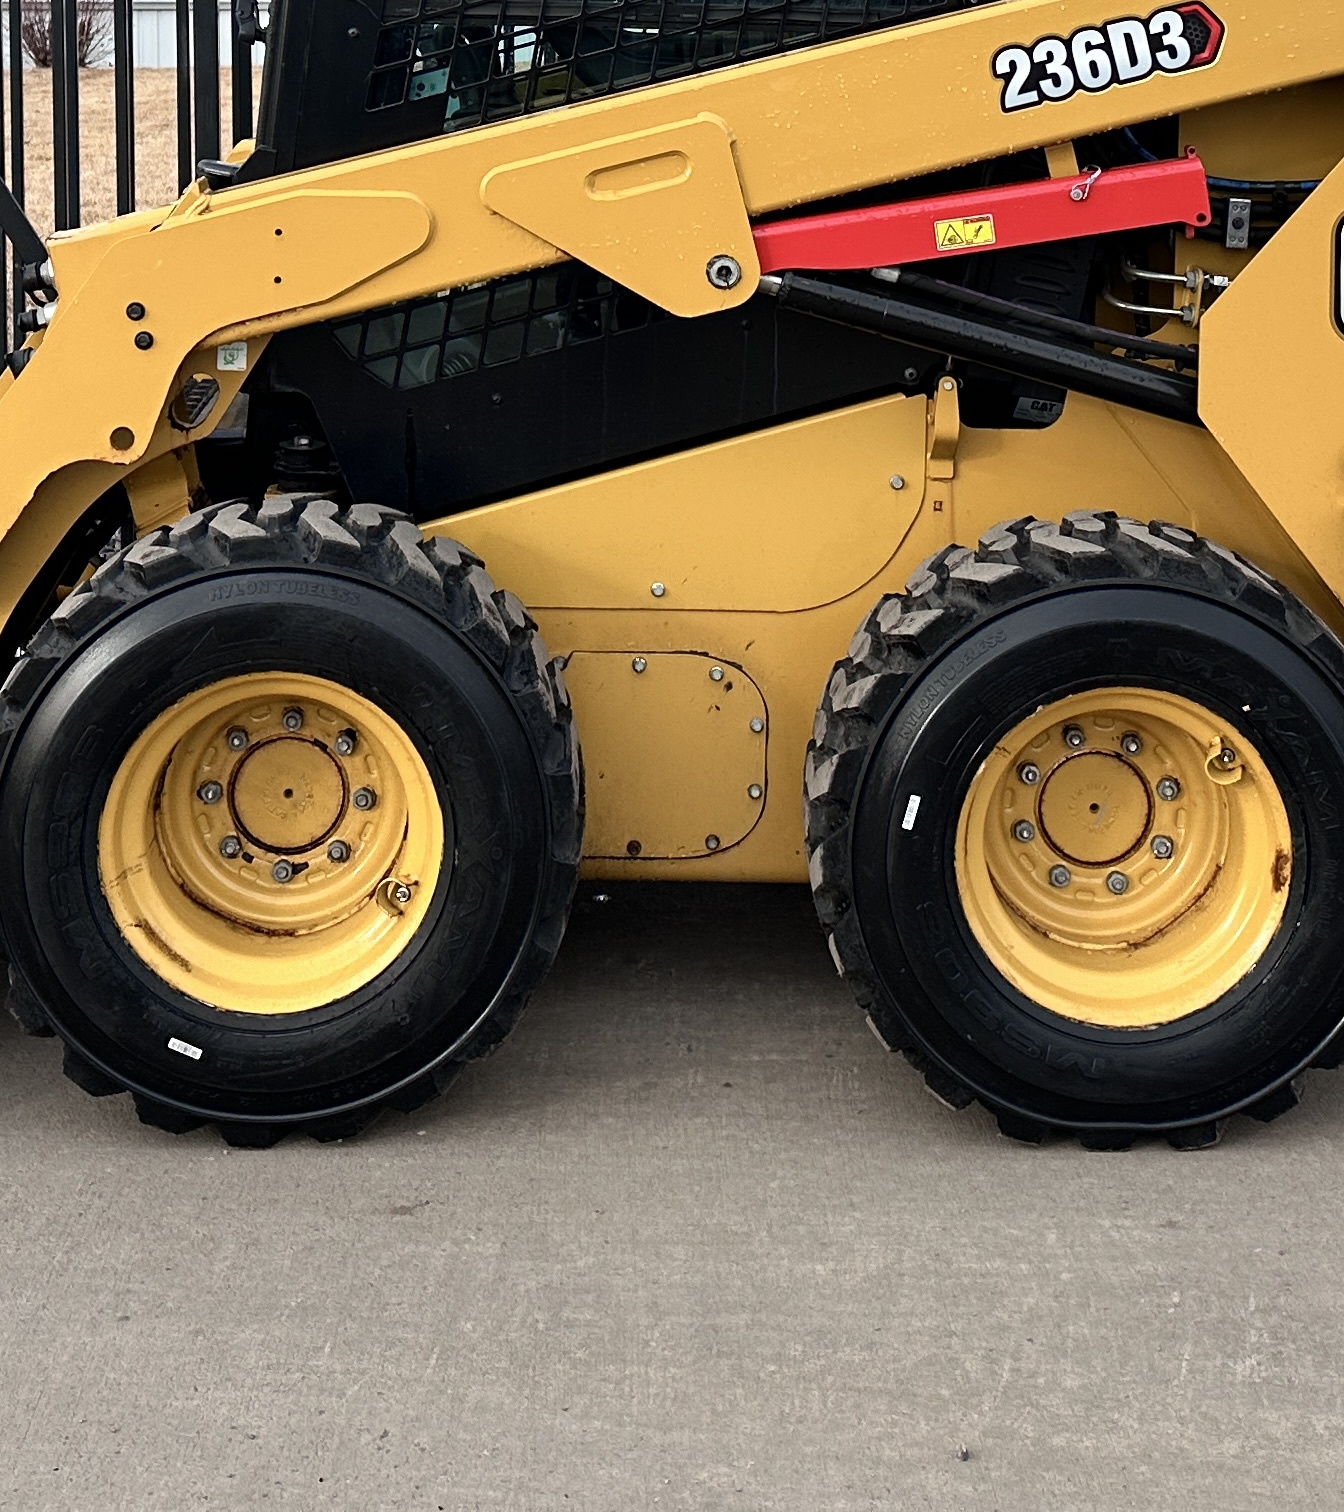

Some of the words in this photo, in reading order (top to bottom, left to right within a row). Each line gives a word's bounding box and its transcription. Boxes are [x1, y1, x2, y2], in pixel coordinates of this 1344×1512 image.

[995, 10, 1192, 109] 236D3
[1030, 400, 1057, 413] CAT
[208, 581, 269, 602] NYLON
[273, 579, 361, 606] TUBELESS
[898, 684, 941, 740] NYLON
[934, 629, 1008, 688] TUBELESS
